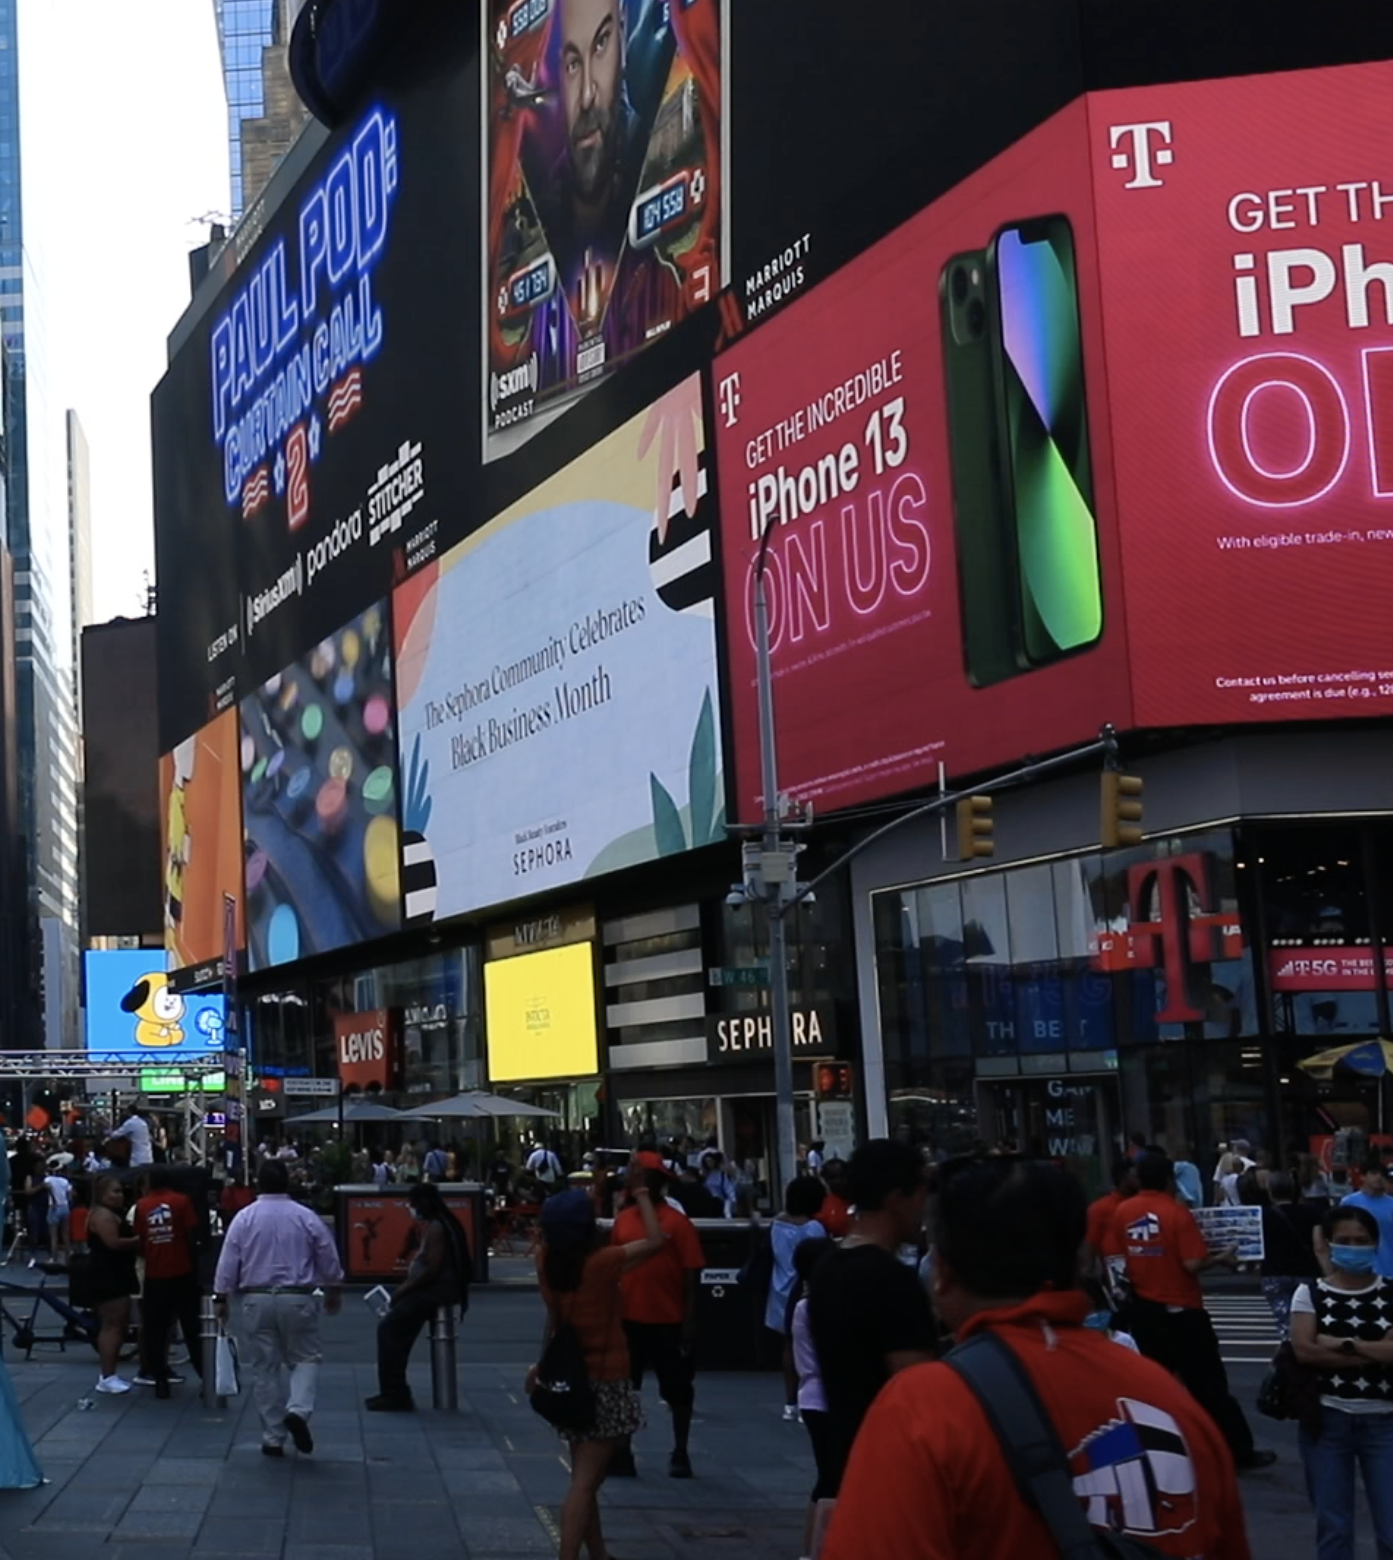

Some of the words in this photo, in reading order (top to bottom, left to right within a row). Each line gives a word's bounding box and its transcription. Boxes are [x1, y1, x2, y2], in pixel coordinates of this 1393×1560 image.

[1228, 186, 1327, 233] GET
[745, 233, 811, 296] MARRIOTT
[747, 265, 805, 320] MARQUIS
[1234, 243, 1393, 337] iPh
[211, 241, 298, 439] PAUL
[225, 344, 311, 502] CURTAIN
[312, 272, 382, 392] CALL
[495, 400, 534, 430] PODCAST
[745, 427, 773, 470] GET
[772, 410, 806, 451] THE
[807, 350, 903, 433] INCREDIBLE
[1207, 346, 1393, 508] O
[287, 428, 309, 526] 2
[368, 458, 424, 525] STITCHER
[749, 442, 859, 541] iPhone
[864, 396, 908, 475] 13
[307, 508, 362, 585] pandora
[744, 520, 830, 655] ON
[841, 472, 931, 614] US
[1217, 535, 1251, 550] With
[1253, 532, 1302, 550] eligible
[1304, 529, 1365, 545] trade-in,
[424, 699, 445, 731] The
[444, 677, 491, 722] Sephora
[490, 635, 568, 696] Community
[568, 595, 647, 656] Celebrates
[1216, 675, 1260, 688] Contact
[1262, 675, 1277, 685] us
[1278, 672, 1315, 685] before
[1250, 688, 1311, 703] agreement
[1326, 685, 1346, 698] due
[450, 721, 488, 771] Black
[488, 700, 551, 756] Business
[553, 664, 612, 725] Month
[512, 837, 573, 876] SEPHORA
[1311, 959, 1337, 976] 5G
[717, 1009, 823, 1052] SEPHRA
